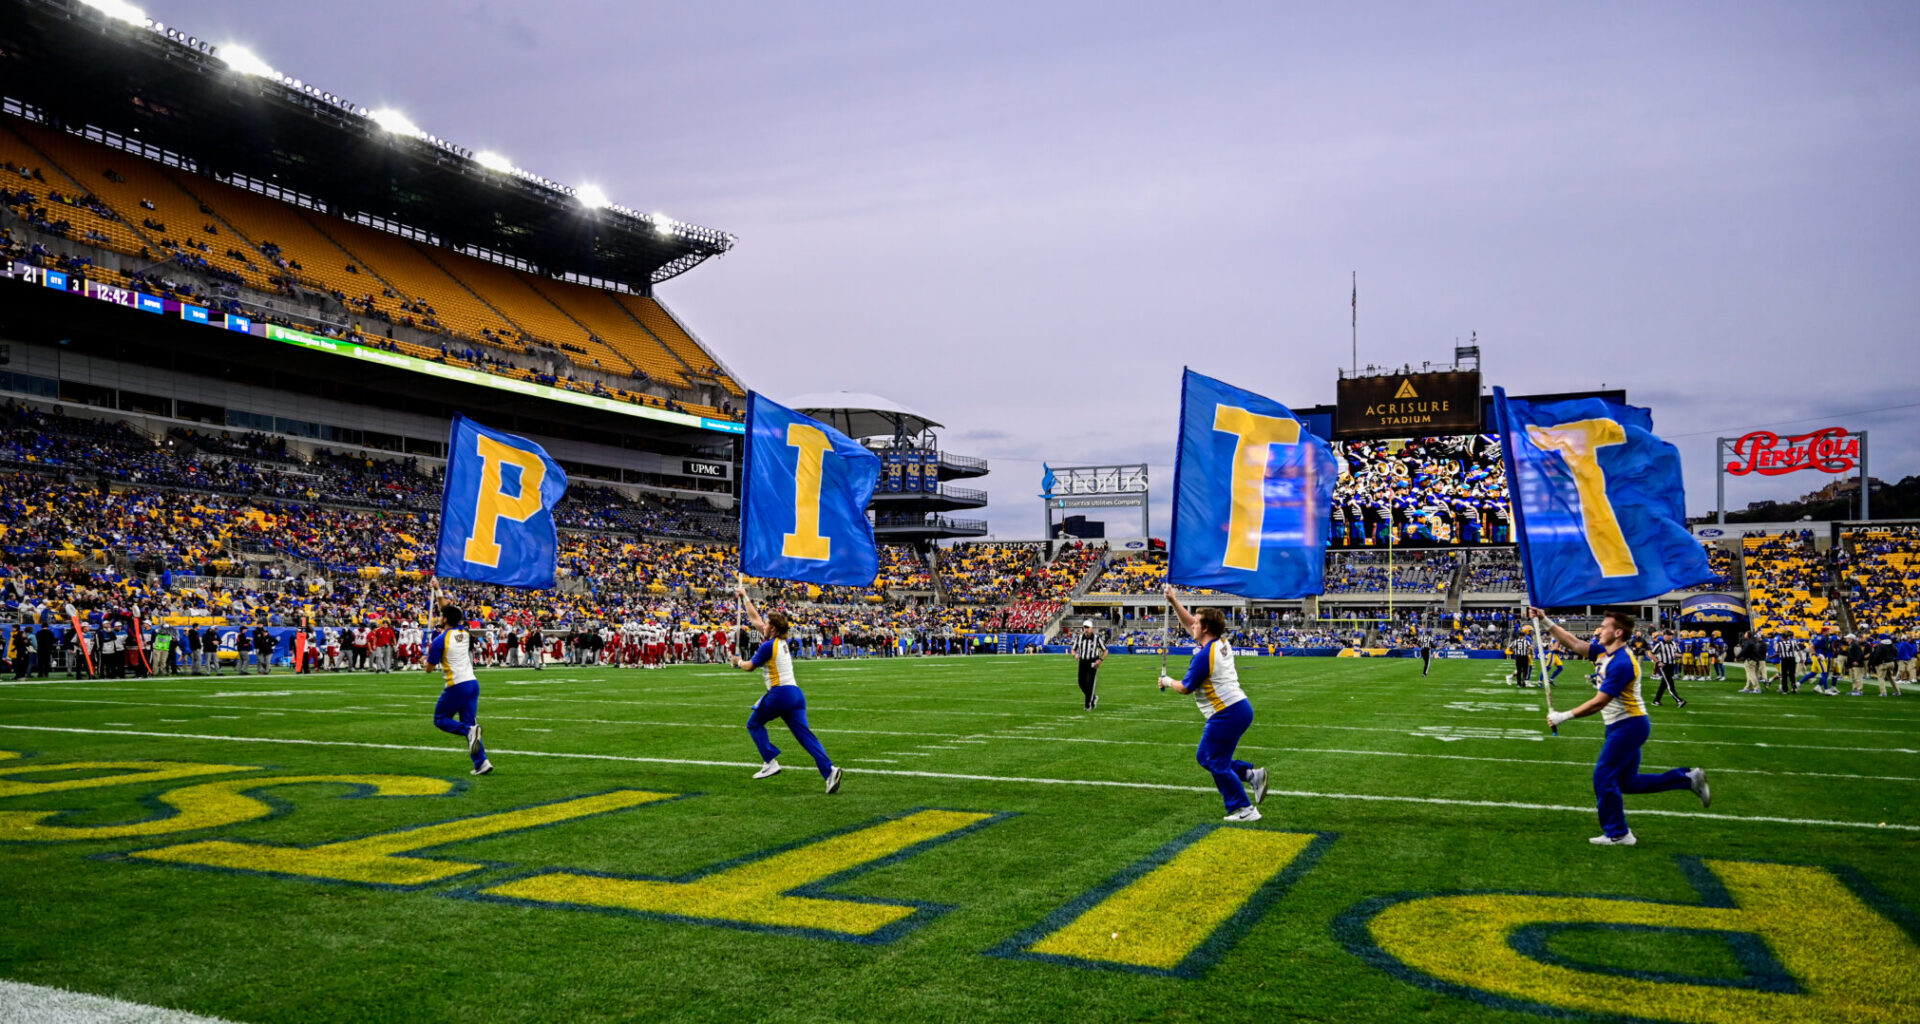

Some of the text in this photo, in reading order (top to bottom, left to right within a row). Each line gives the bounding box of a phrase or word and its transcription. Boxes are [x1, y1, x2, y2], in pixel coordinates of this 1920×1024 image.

[23, 265, 37, 283] 21
[72, 279, 79, 291] 3
[96, 284, 128, 305] 12:42
[1365, 401, 1449, 416] ACRISURE
[1381, 415, 1431, 425] STADIUM
[690, 463, 720, 475] UPMC
[889, 463, 901, 477] 33
[907, 463, 920, 477] 42
[925, 464, 938, 477] 65
[782, 423, 834, 561] I
[1060, 475, 1149, 495] PEOPLES
[1213, 404, 1301, 571] T
[463, 433, 546, 569] P
[1526, 417, 1638, 578] T
